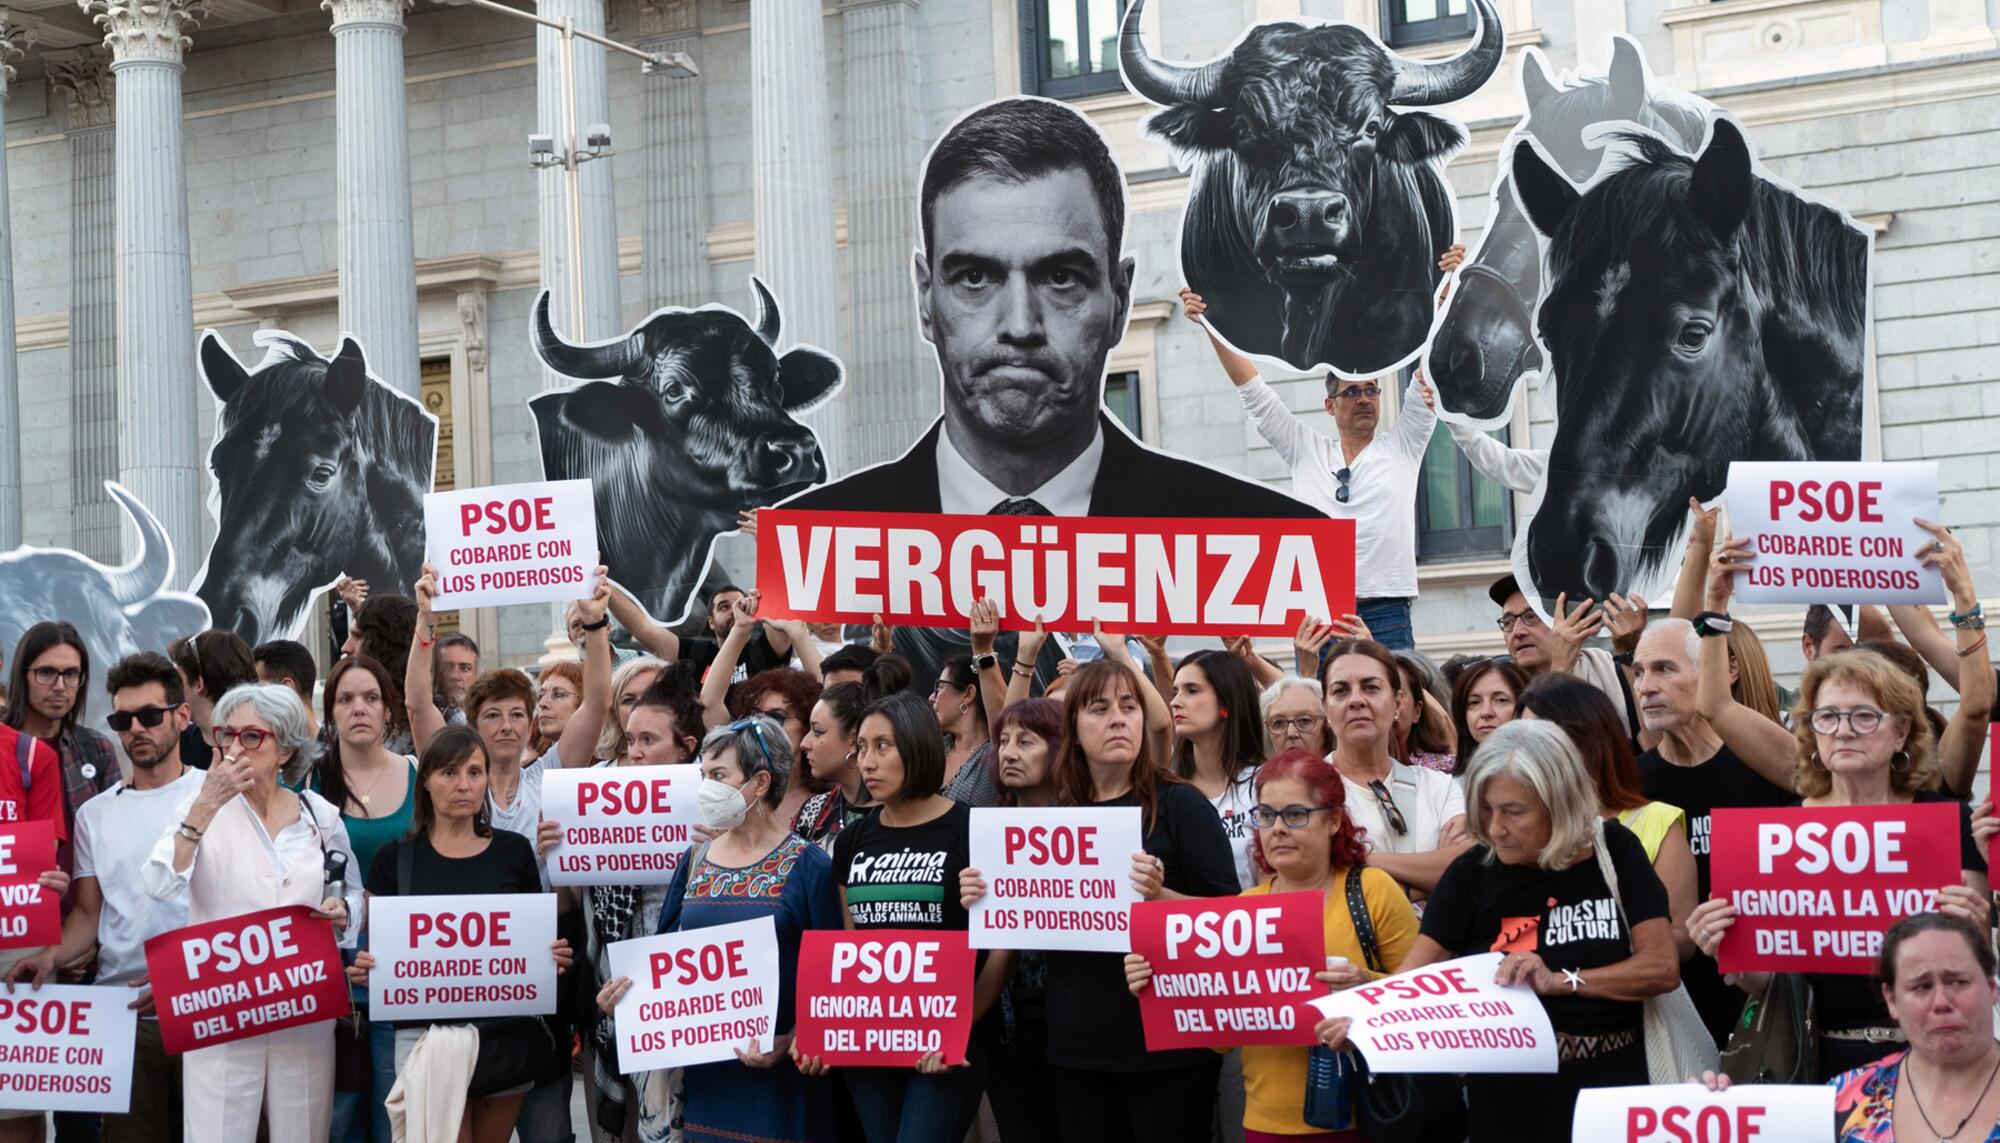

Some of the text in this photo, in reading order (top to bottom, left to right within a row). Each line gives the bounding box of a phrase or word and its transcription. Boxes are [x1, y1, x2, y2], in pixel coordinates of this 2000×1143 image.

[1770, 480, 1883, 523] PSOE
[461, 497, 556, 537] PSOE
[450, 540, 571, 566] COBARDE CON
[1758, 533, 1903, 558] COBARDE CON
[442, 565, 584, 594] LOS PODEROSOS
[776, 524, 1332, 626] VERGÜENZA
[1749, 566, 1920, 590] LOS PODEROSOS
[578, 779, 671, 816] PSOE
[567, 824, 687, 845] COBARDE CON
[1005, 826, 1099, 866] PSOE
[1758, 821, 1908, 874] PSOE
[559, 852, 684, 872] LOS PODEROS
[874, 847, 948, 869] anima
[869, 866, 944, 883] naturalis
[0, 884, 42, 906] VOZ
[994, 878, 1116, 899] COBARDE CON
[860, 903, 872, 913] LA
[875, 902, 921, 912] DEFENSA
[929, 903, 943, 913] DE
[1733, 889, 1941, 916] IGNORA LA VOZ
[409, 911, 511, 948] PSOE
[870, 912, 887, 923] LOS
[889, 912, 943, 923] ANIMALES
[984, 910, 1128, 931] LOS PODEROSOS
[1166, 907, 1283, 960] PSOE
[1545, 919, 1620, 946] CULTURA
[1755, 929, 1886, 958] DEL PUEB
[182, 916, 299, 980] PSOE
[394, 957, 526, 979] COBARDE CON
[649, 939, 748, 990] PSOE
[831, 941, 940, 984] PSOE
[171, 960, 327, 1016] IGNORA LA VOZ
[384, 984, 537, 1005] LOS PODEROSOS
[1152, 967, 1311, 998] IGNORA LA VOZ
[1354, 967, 1479, 1005] PSOE
[192, 994, 317, 1040] DEL PUEBLO
[639, 986, 763, 1022] COBARDE CON
[810, 996, 957, 1019] IGNORA LA VOZ
[1366, 1000, 1515, 1028] COBARDE CON
[1174, 1005, 1295, 1033] DEL PUEBLO
[630, 1015, 769, 1053] LOS PODEROSOS
[824, 1029, 941, 1052] DEL PUEBLO
[1371, 1027, 1537, 1052] LOS PODEROSOS
[0, 1044, 103, 1065] BARDE CON
[0, 1073, 112, 1094] PODEROSOS
